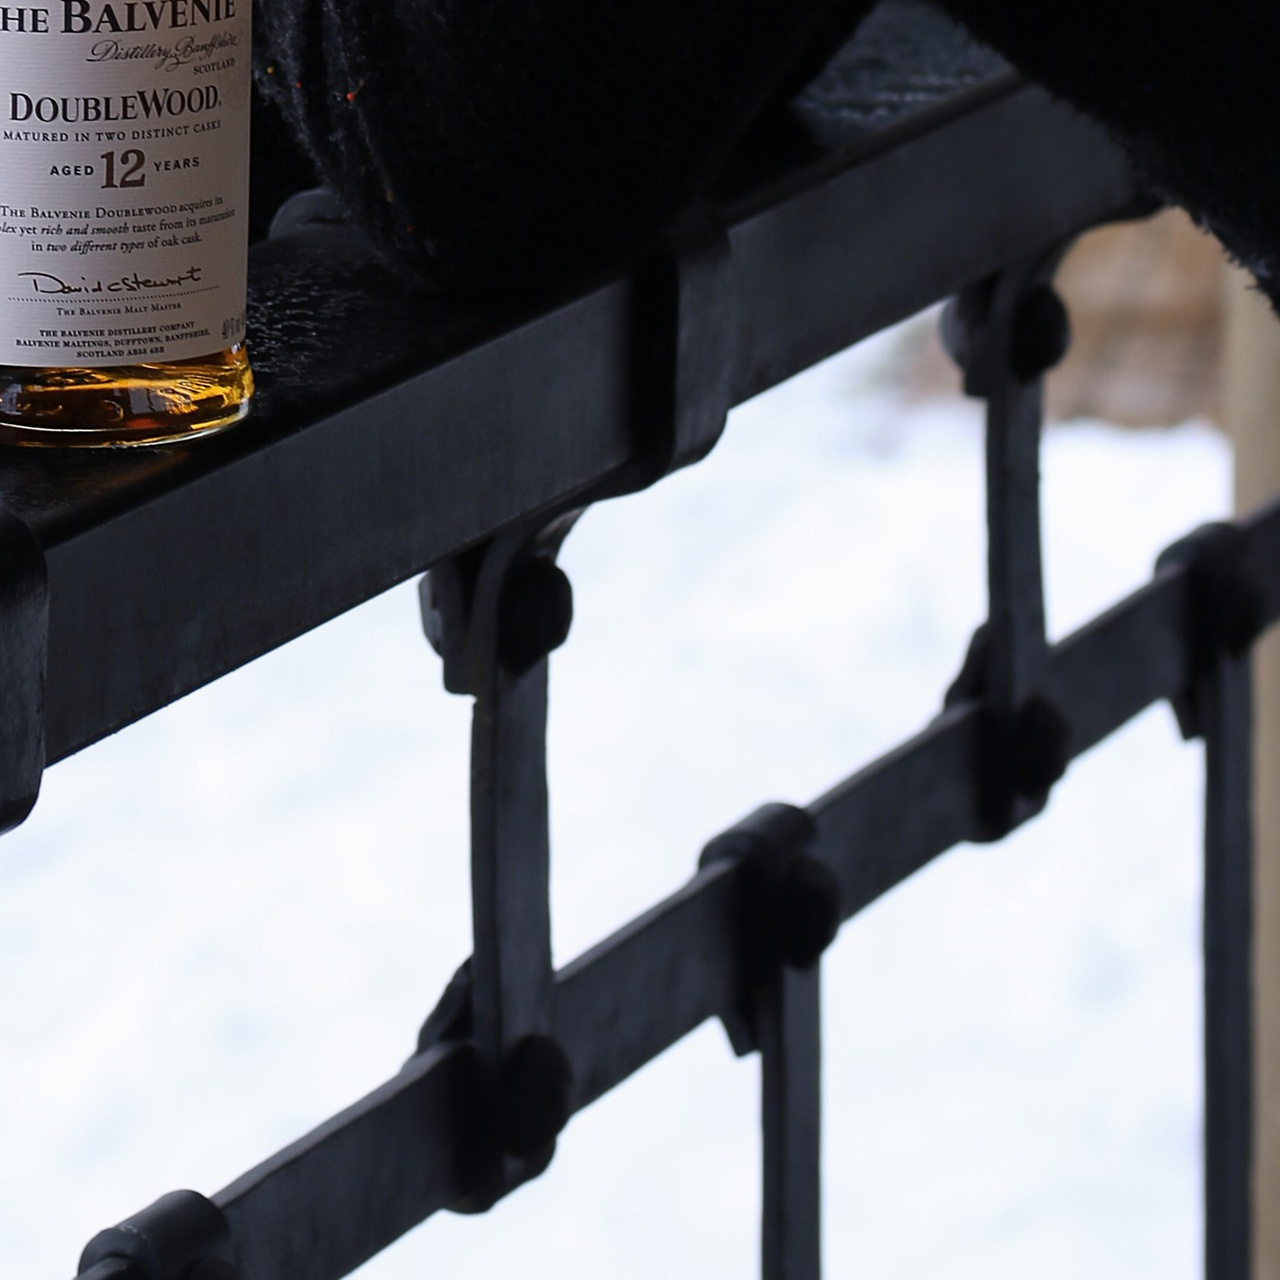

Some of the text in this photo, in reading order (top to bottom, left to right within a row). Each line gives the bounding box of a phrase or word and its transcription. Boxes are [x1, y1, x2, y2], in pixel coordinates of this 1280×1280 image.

[193, 57, 236, 76] SCOTLAND
[3, 120, 222, 142] MATURED IN TWO DISTINCT CASKS
[49, 148, 200, 189] AGED 12 YEARS
[178, 198, 214, 214] acquires
[18, 226, 38, 237] yet
[40, 224, 63, 236] rich
[65, 224, 88, 235] and
[90, 224, 130, 235] smooth
[132, 222, 157, 233] taste
[159, 219, 184, 232] from
[185, 217, 197, 228] its
[31, 240, 43, 252] in
[46, 242, 68, 252] two
[70, 240, 117, 255] different
[120, 241, 145, 254] types
[147, 237, 160, 249] of
[161, 235, 180, 247] oak
[56, 307, 76, 316] THE
[79, 307, 122, 316] BALVENIE
[124, 304, 149, 314] MALT
[39, 321, 195, 337] THE BALVENIE DISTILLERY COMPANY
[16, 338, 60, 348] BALVENIE
[62, 339, 112, 348] MALTINGS,
[76, 348, 125, 358] SCOTLAND
